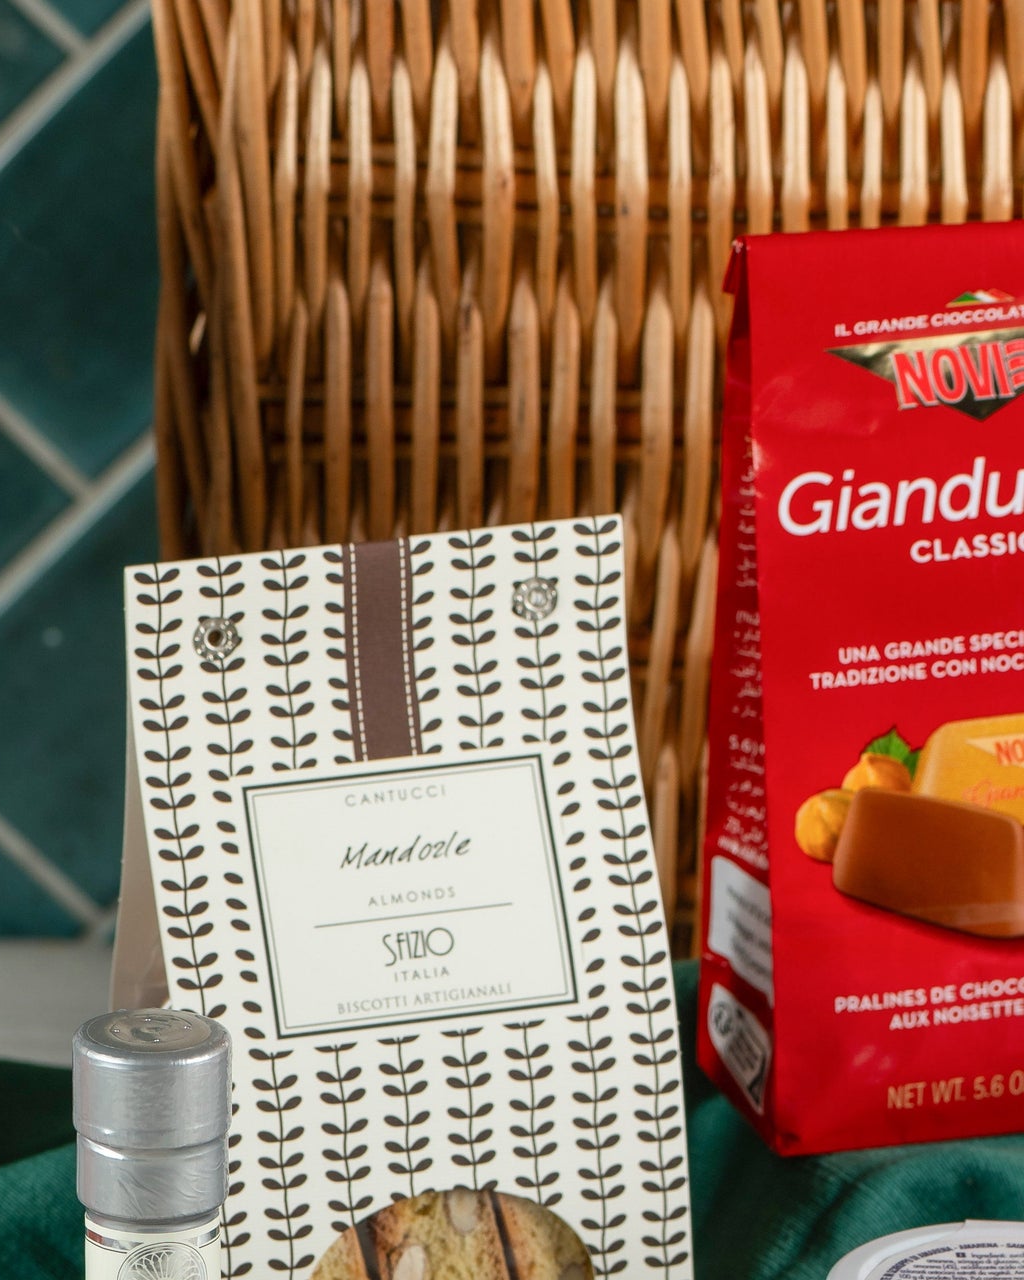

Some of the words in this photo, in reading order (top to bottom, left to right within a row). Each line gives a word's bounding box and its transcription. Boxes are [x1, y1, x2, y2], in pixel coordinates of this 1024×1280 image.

[835, 324, 851, 337] IL
[853, 315, 928, 334] GRANDE
[891, 340, 1014, 409] NOVI
[838, 645, 880, 665] UNA
[884, 636, 965, 660] GRANDE
[809, 662, 927, 690] TRADIZIONE
[931, 658, 977, 679] CON
[344, 784, 446, 807] CANTUCCI
[367, 886, 456, 907] ALMONDS
[382, 927, 454, 967] SFIZIO
[394, 966, 450, 983] ITALIA
[337, 996, 409, 1015] BISCOTTI
[414, 982, 512, 1006] ARTIGIANALI
[834, 988, 927, 1014] PRALINES
[930, 984, 957, 1005] DE
[889, 1010, 930, 1031] AUX
[887, 1082, 926, 1110] NET
[973, 1073, 1005, 1100] 5.6
